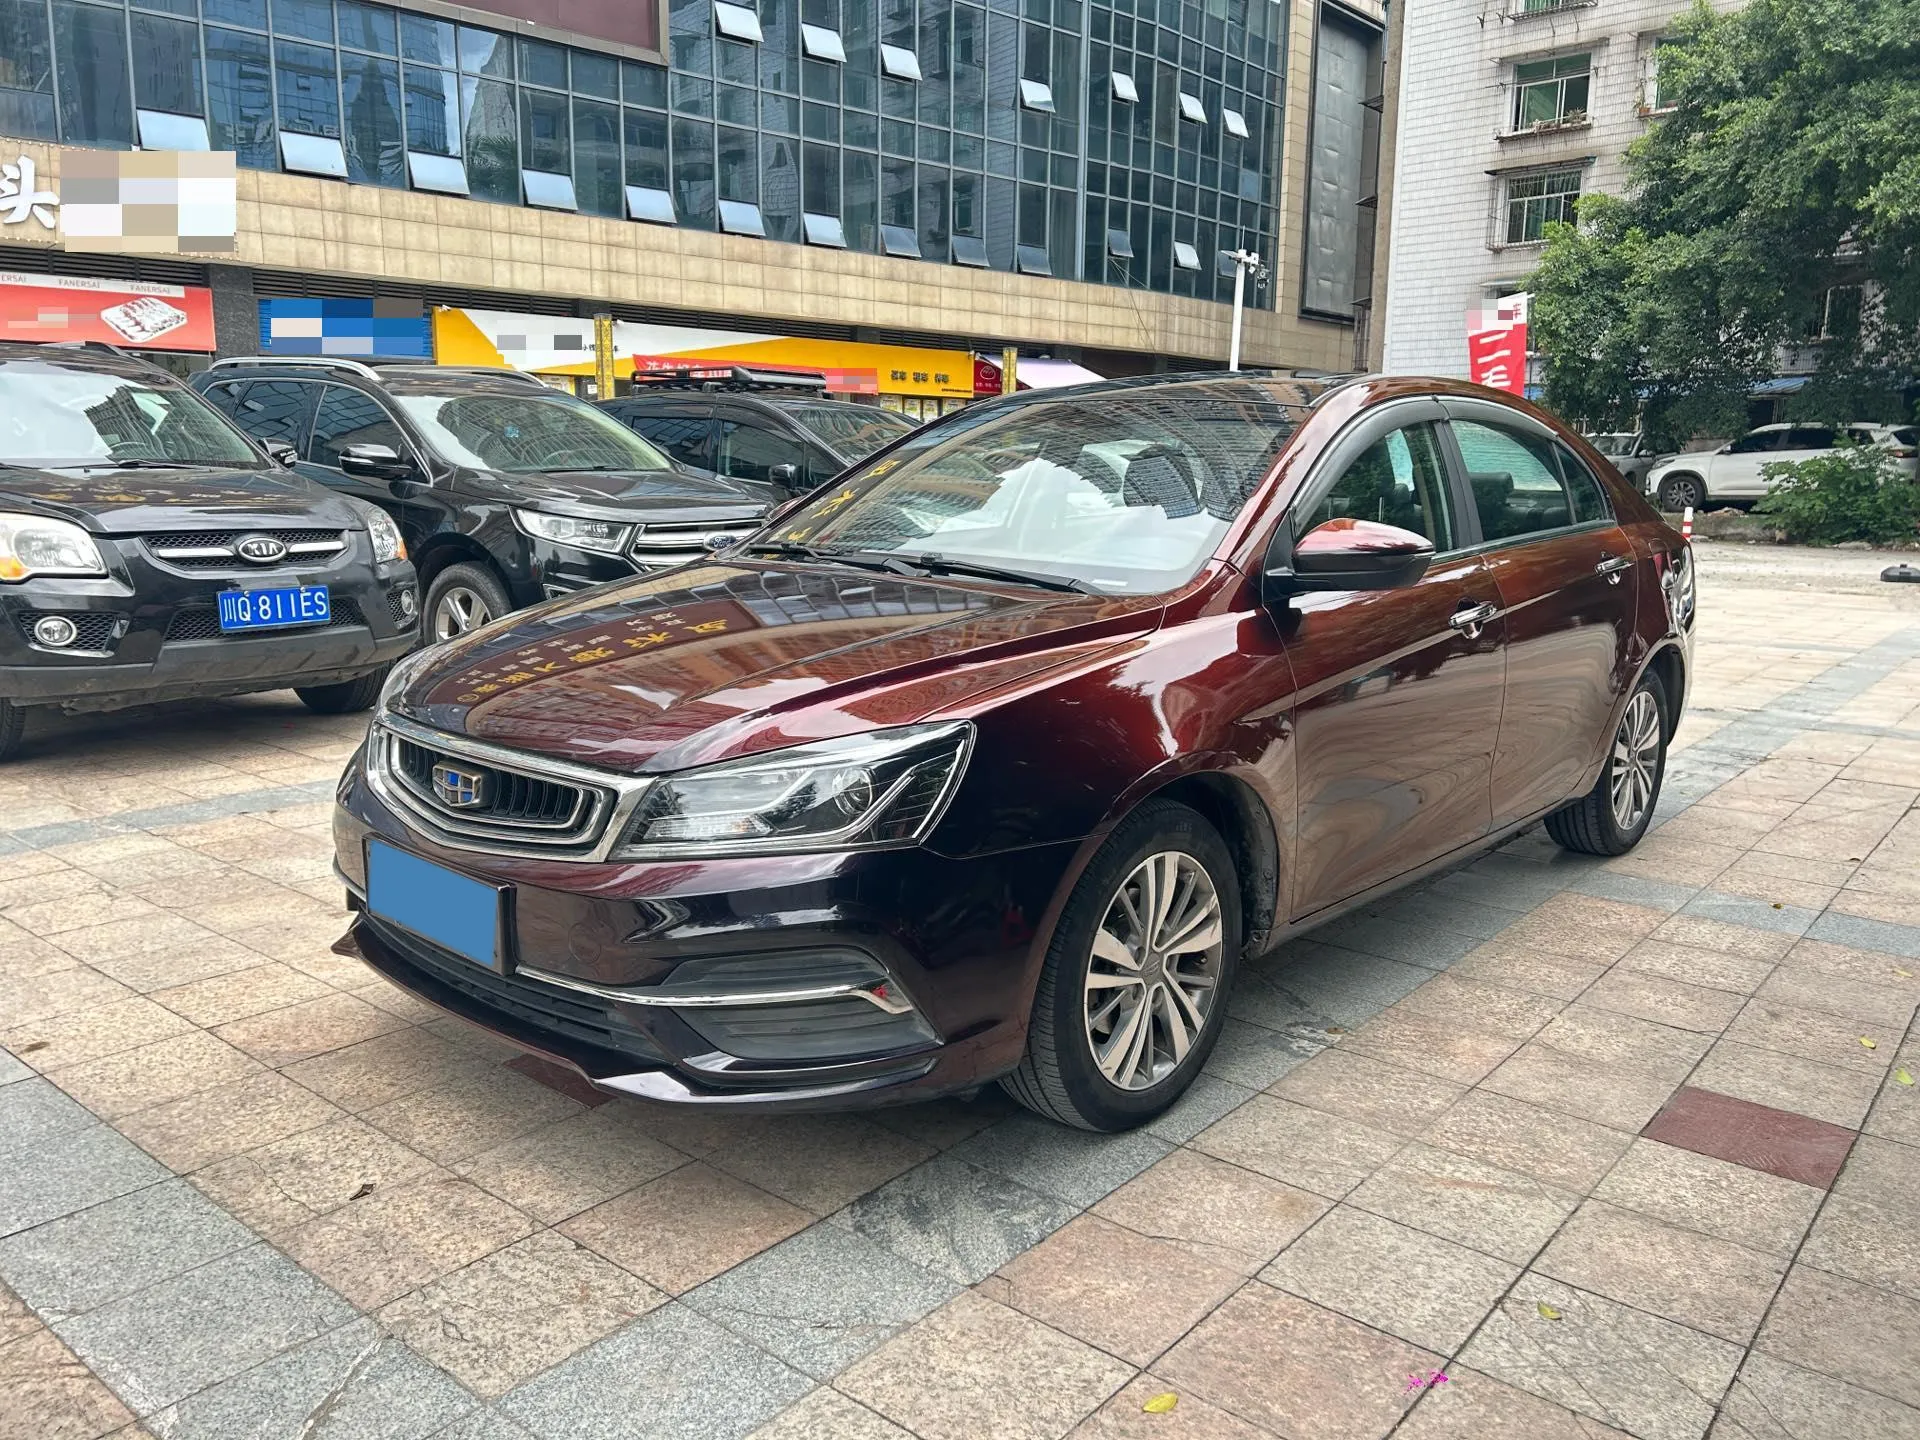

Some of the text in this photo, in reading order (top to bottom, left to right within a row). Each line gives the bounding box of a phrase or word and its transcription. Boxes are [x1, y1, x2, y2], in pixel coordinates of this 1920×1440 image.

[0, 154, 60, 229] 头
[58, 278, 101, 289] FANERSAI
[130, 284, 171, 295] FANERSAI
[247, 542, 279, 556] KIA
